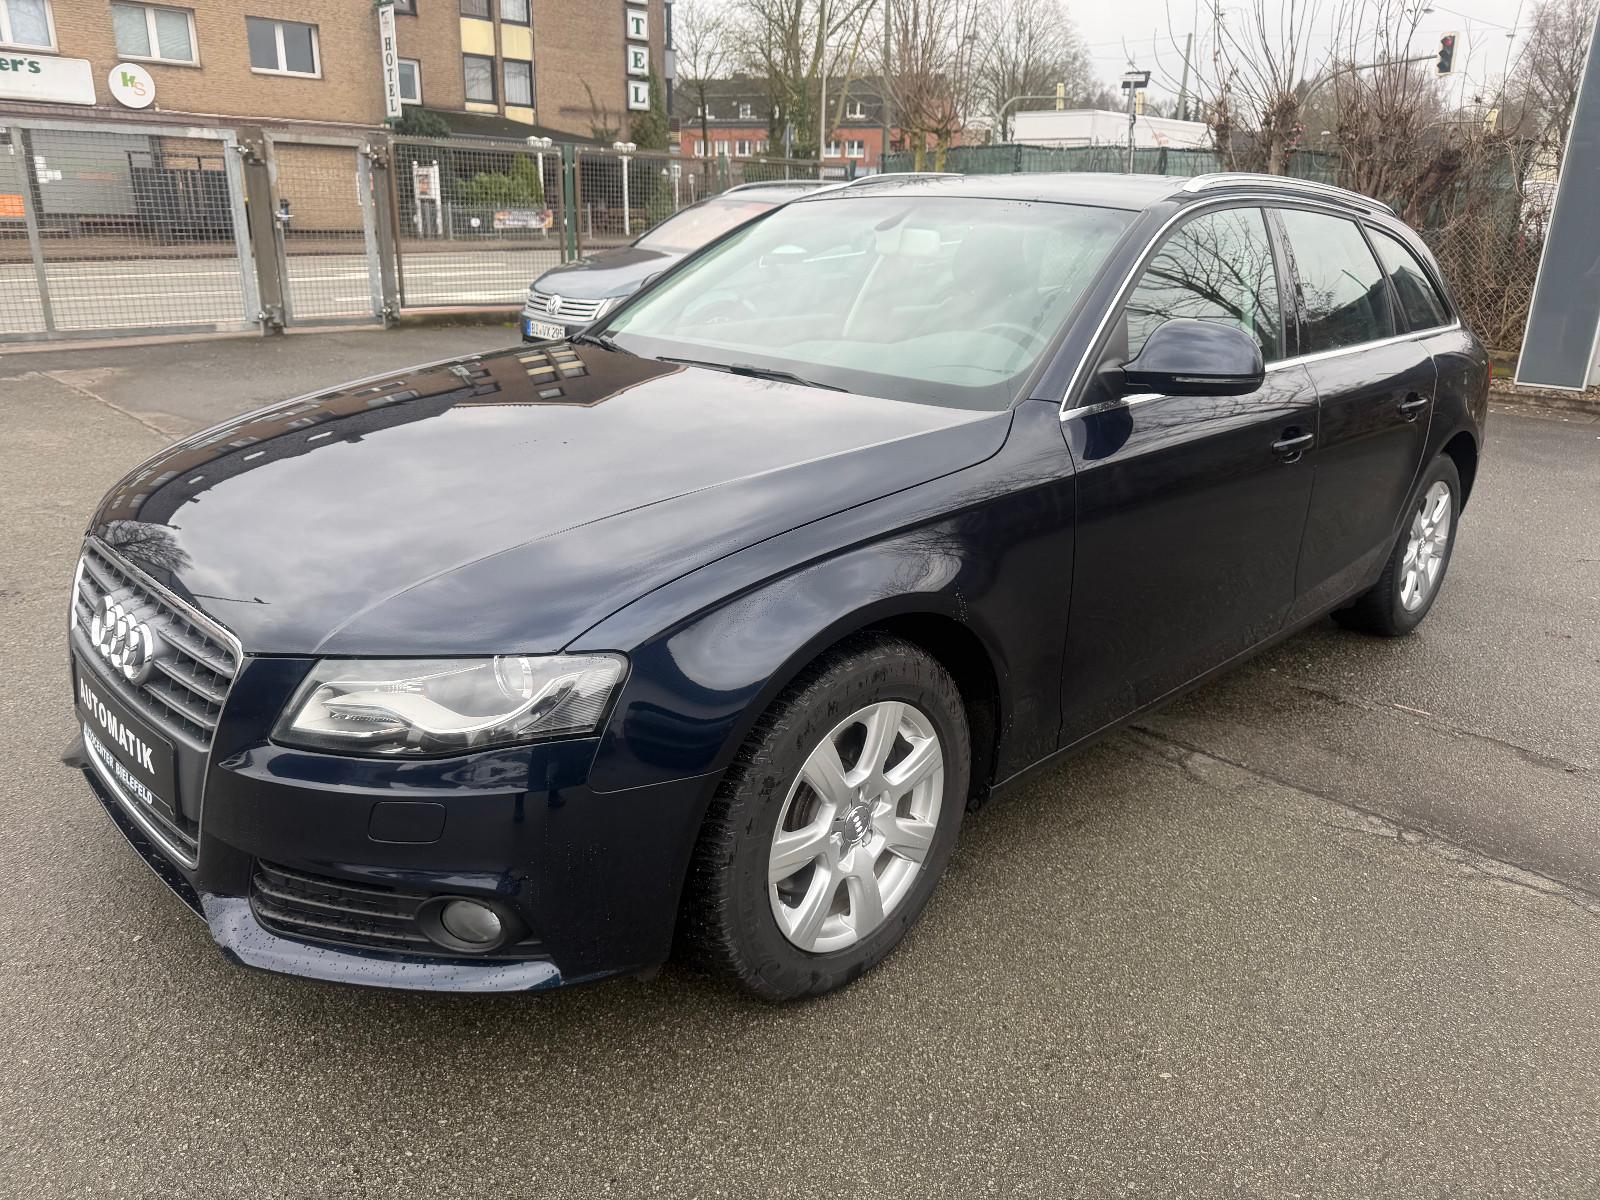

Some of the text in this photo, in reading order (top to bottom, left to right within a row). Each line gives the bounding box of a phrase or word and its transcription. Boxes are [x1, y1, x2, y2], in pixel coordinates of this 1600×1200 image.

[385, 37, 397, 112] HOTEL
[80, 677, 155, 775] AUTOMATIK
[115, 761, 153, 805] BIELEFELD
